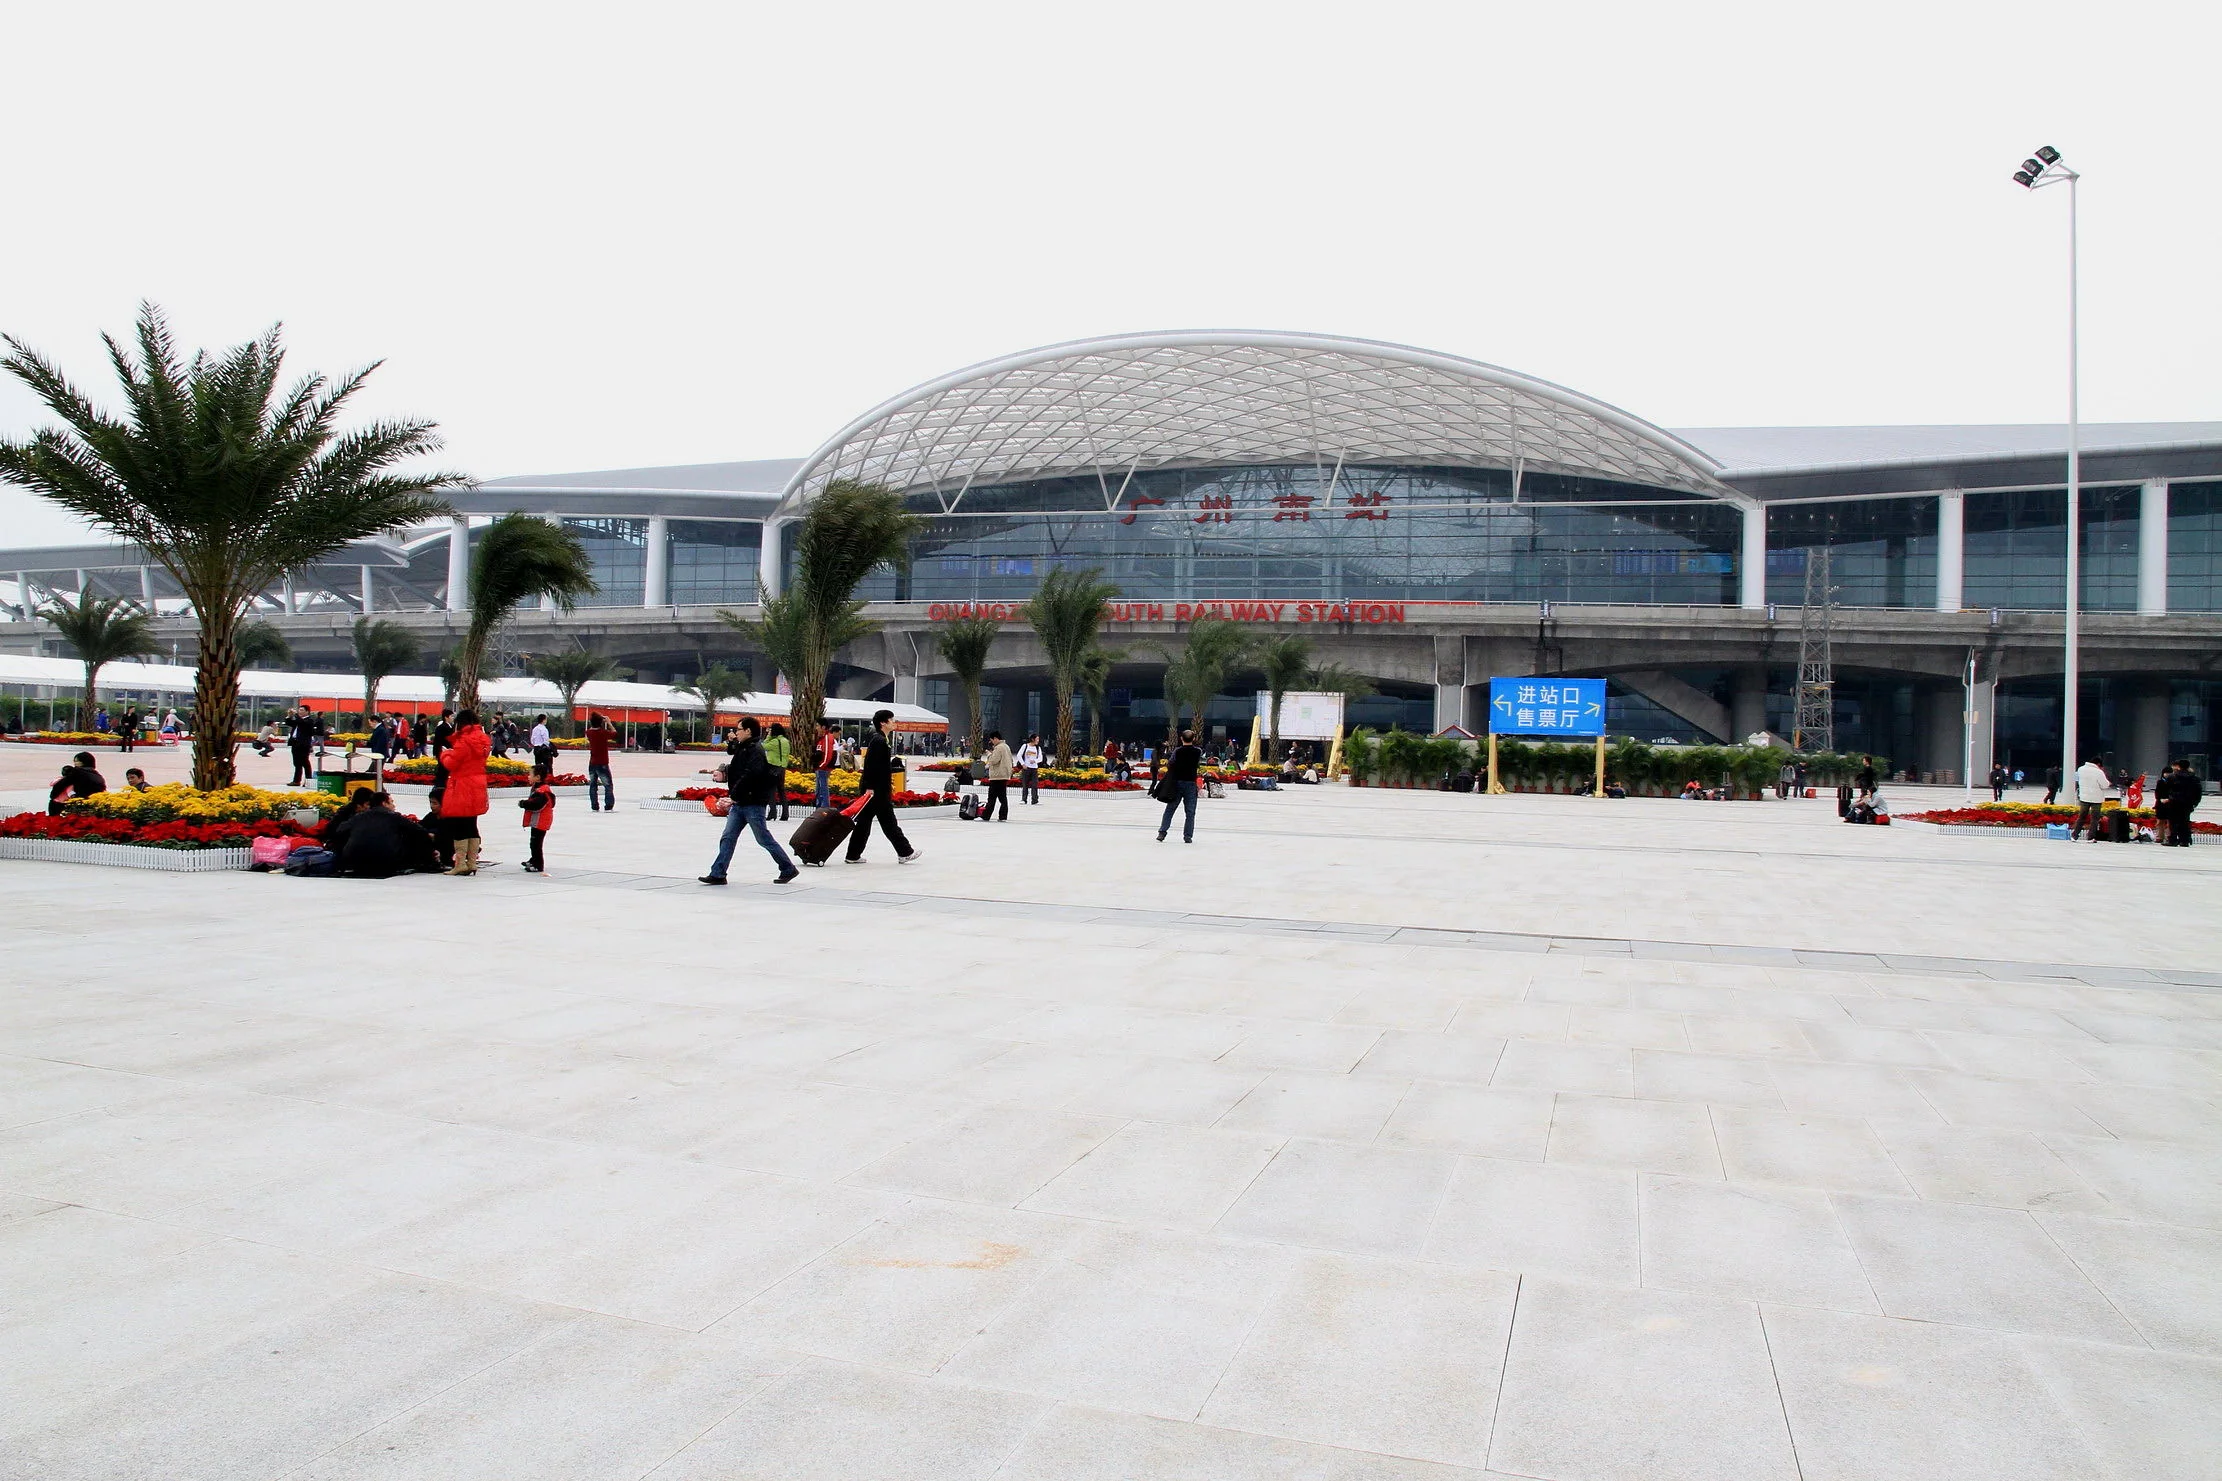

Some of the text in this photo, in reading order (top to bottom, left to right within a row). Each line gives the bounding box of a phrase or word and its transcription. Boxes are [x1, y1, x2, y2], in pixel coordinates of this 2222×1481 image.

[1120, 490, 1392, 525] 广州南站
[1096, 603, 1164, 622] OUTH
[1297, 604, 1405, 623] STATION
[1517, 685, 1580, 705] 进站口
[1516, 707, 1580, 728] 售票厅
